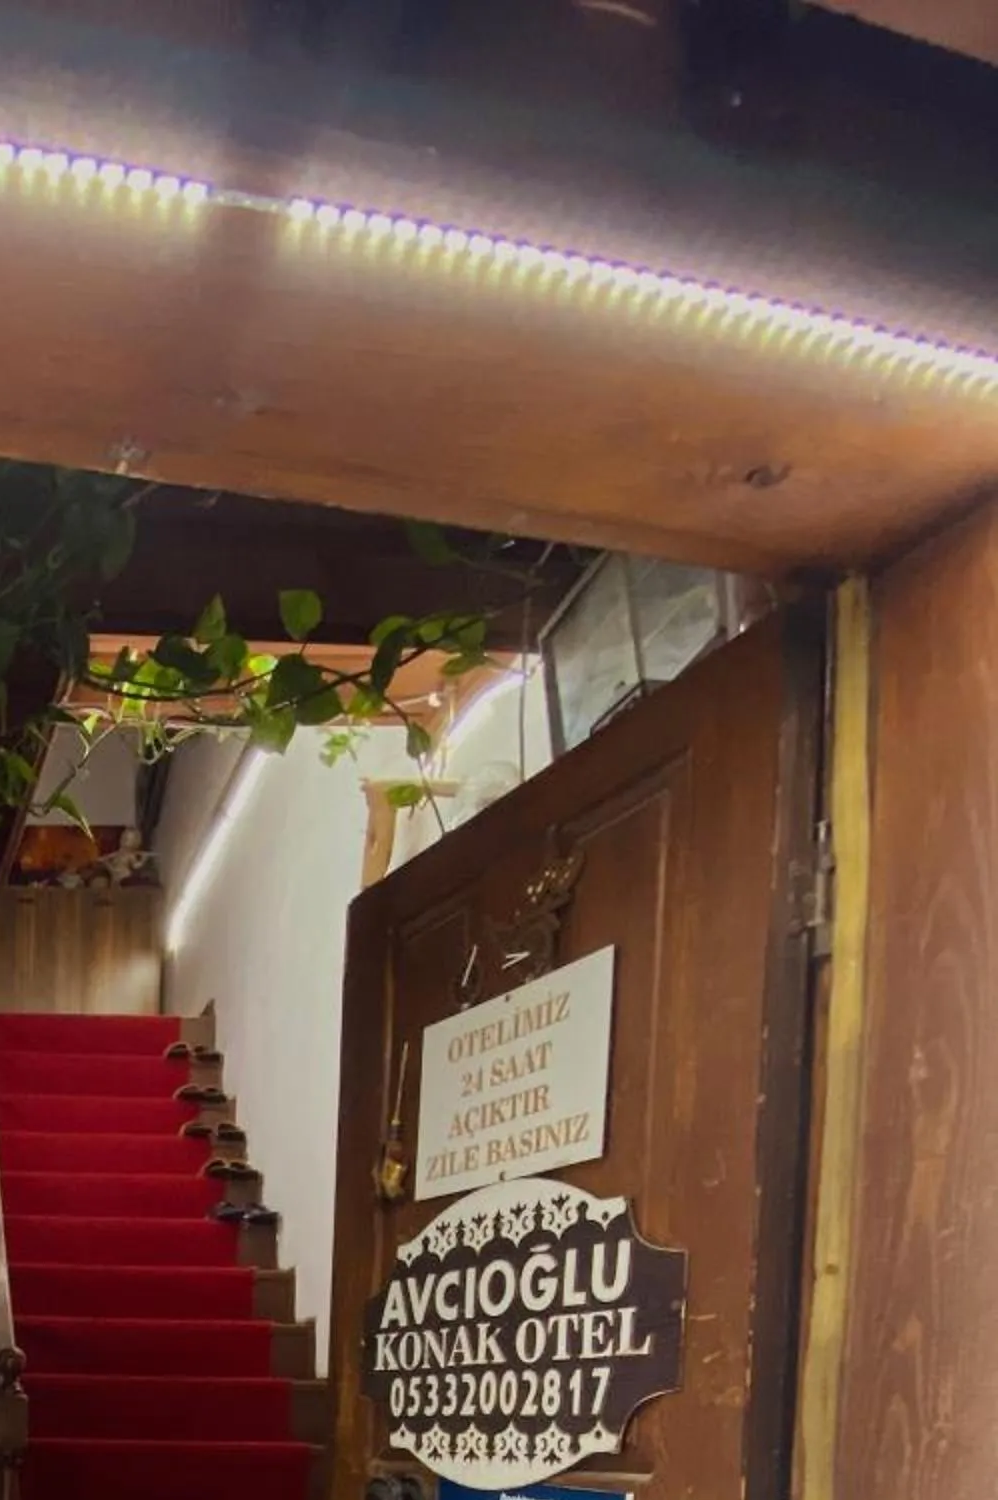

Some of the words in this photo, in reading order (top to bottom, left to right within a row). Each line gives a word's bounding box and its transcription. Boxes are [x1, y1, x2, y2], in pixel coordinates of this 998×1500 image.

[447, 990, 571, 1063] OTELİMİZ
[460, 1069, 484, 1098] 24
[489, 1041, 553, 1088] SAAT
[448, 1083, 551, 1140] AÇIKTIR
[486, 1112, 590, 1167] BASINIZ
[379, 1239, 632, 1329] AVCIOĞLU
[373, 1321, 507, 1372] KONAK
[515, 1306, 652, 1364] OTEL
[389, 1366, 612, 1418] 05332002817
